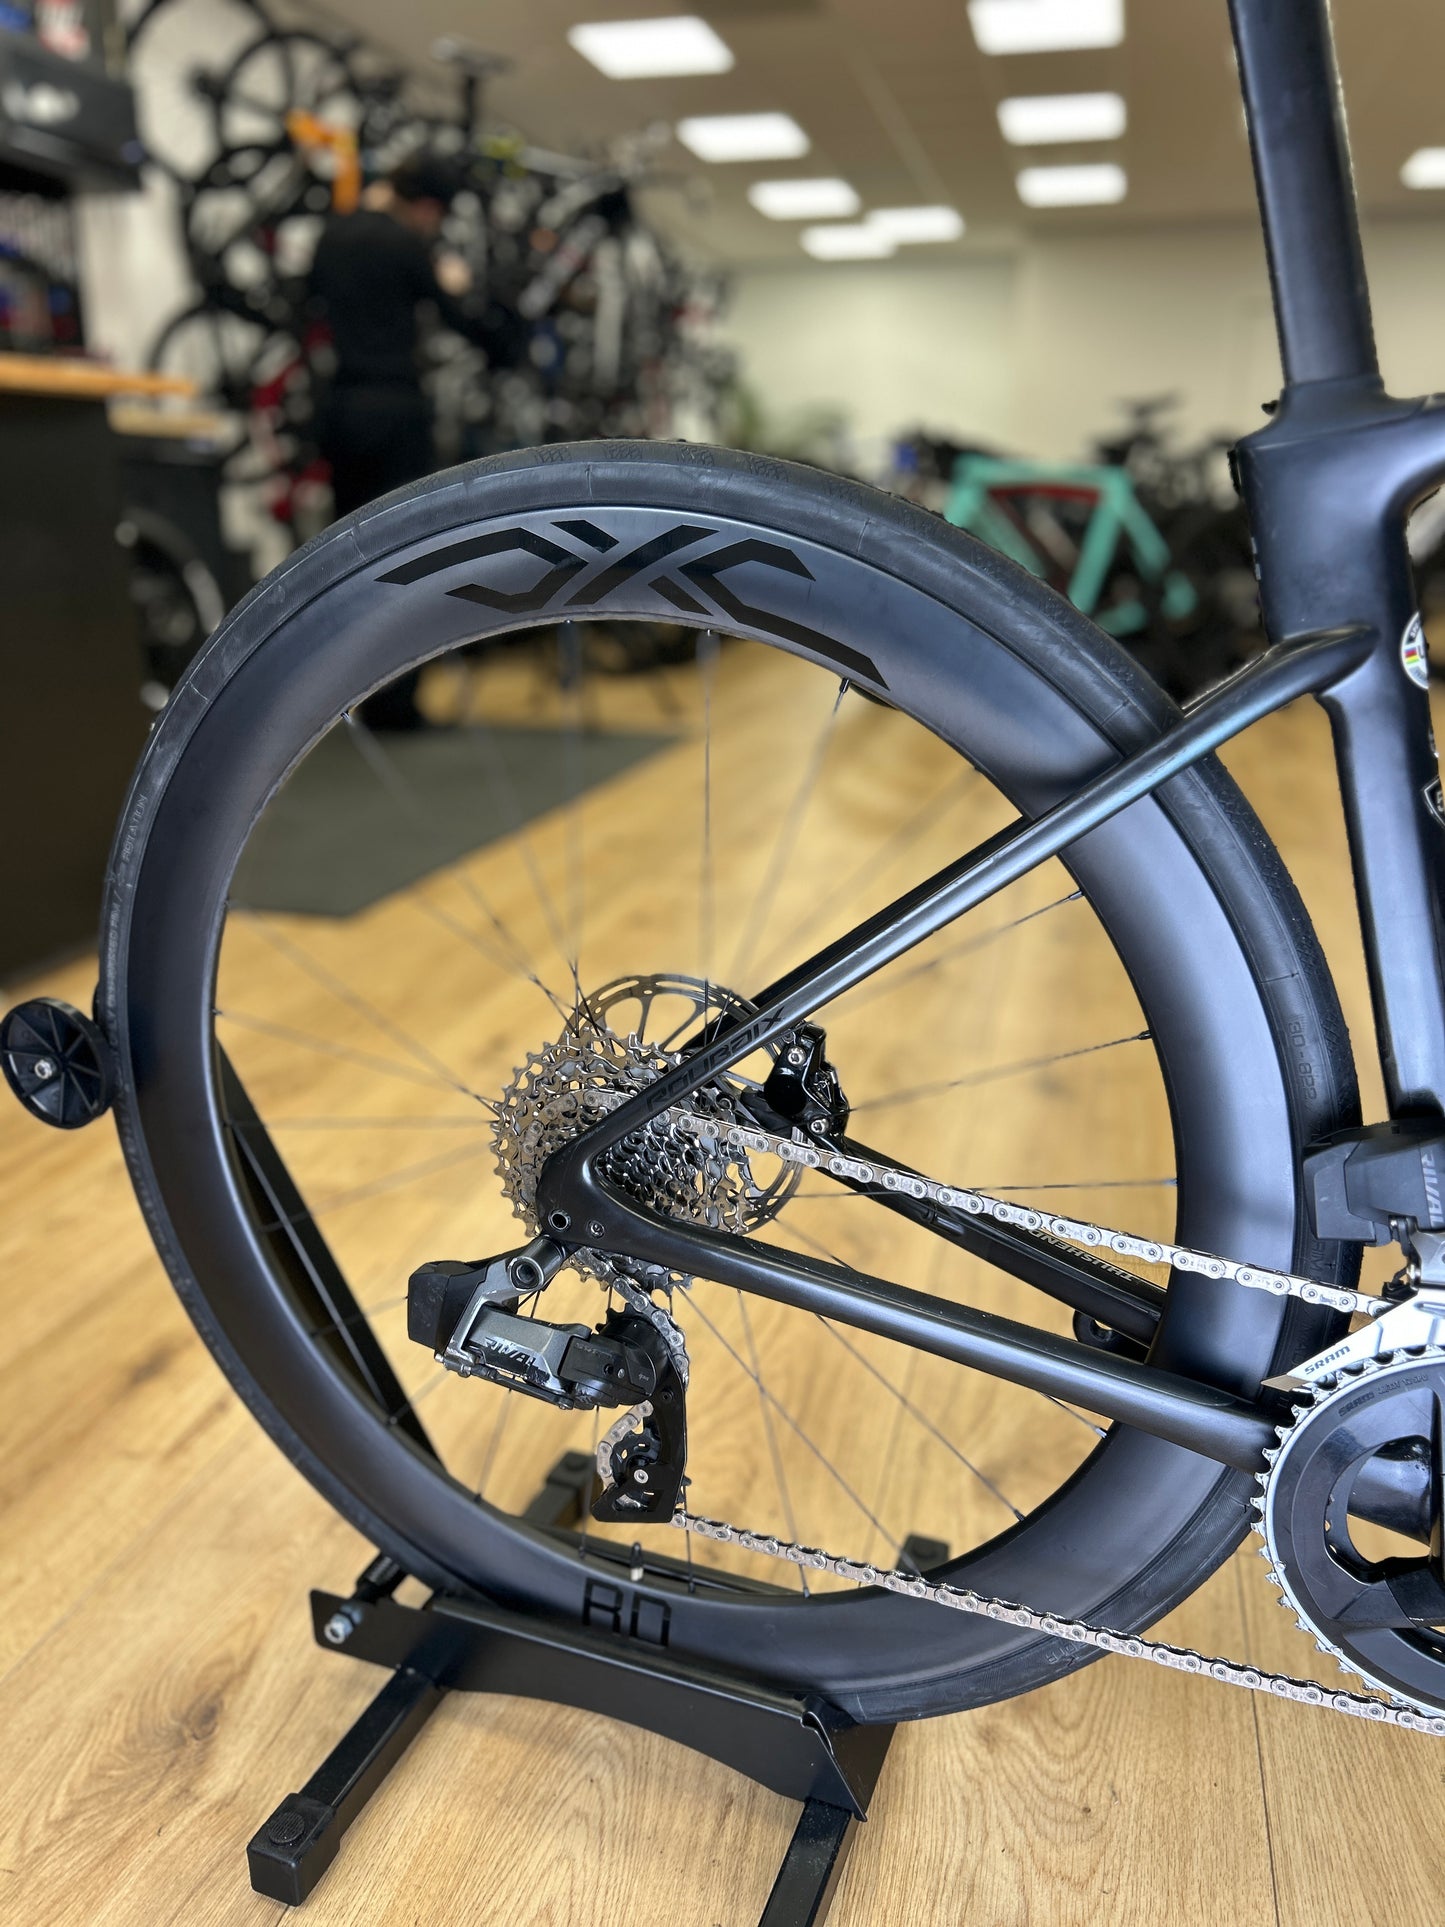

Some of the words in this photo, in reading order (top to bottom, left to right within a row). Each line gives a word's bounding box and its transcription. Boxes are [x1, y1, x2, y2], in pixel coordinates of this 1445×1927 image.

[646, 1006, 785, 1113] ROUBAIX
[484, 1336, 537, 1366] RIVAL
[1304, 1345, 1351, 1375] SRAM
